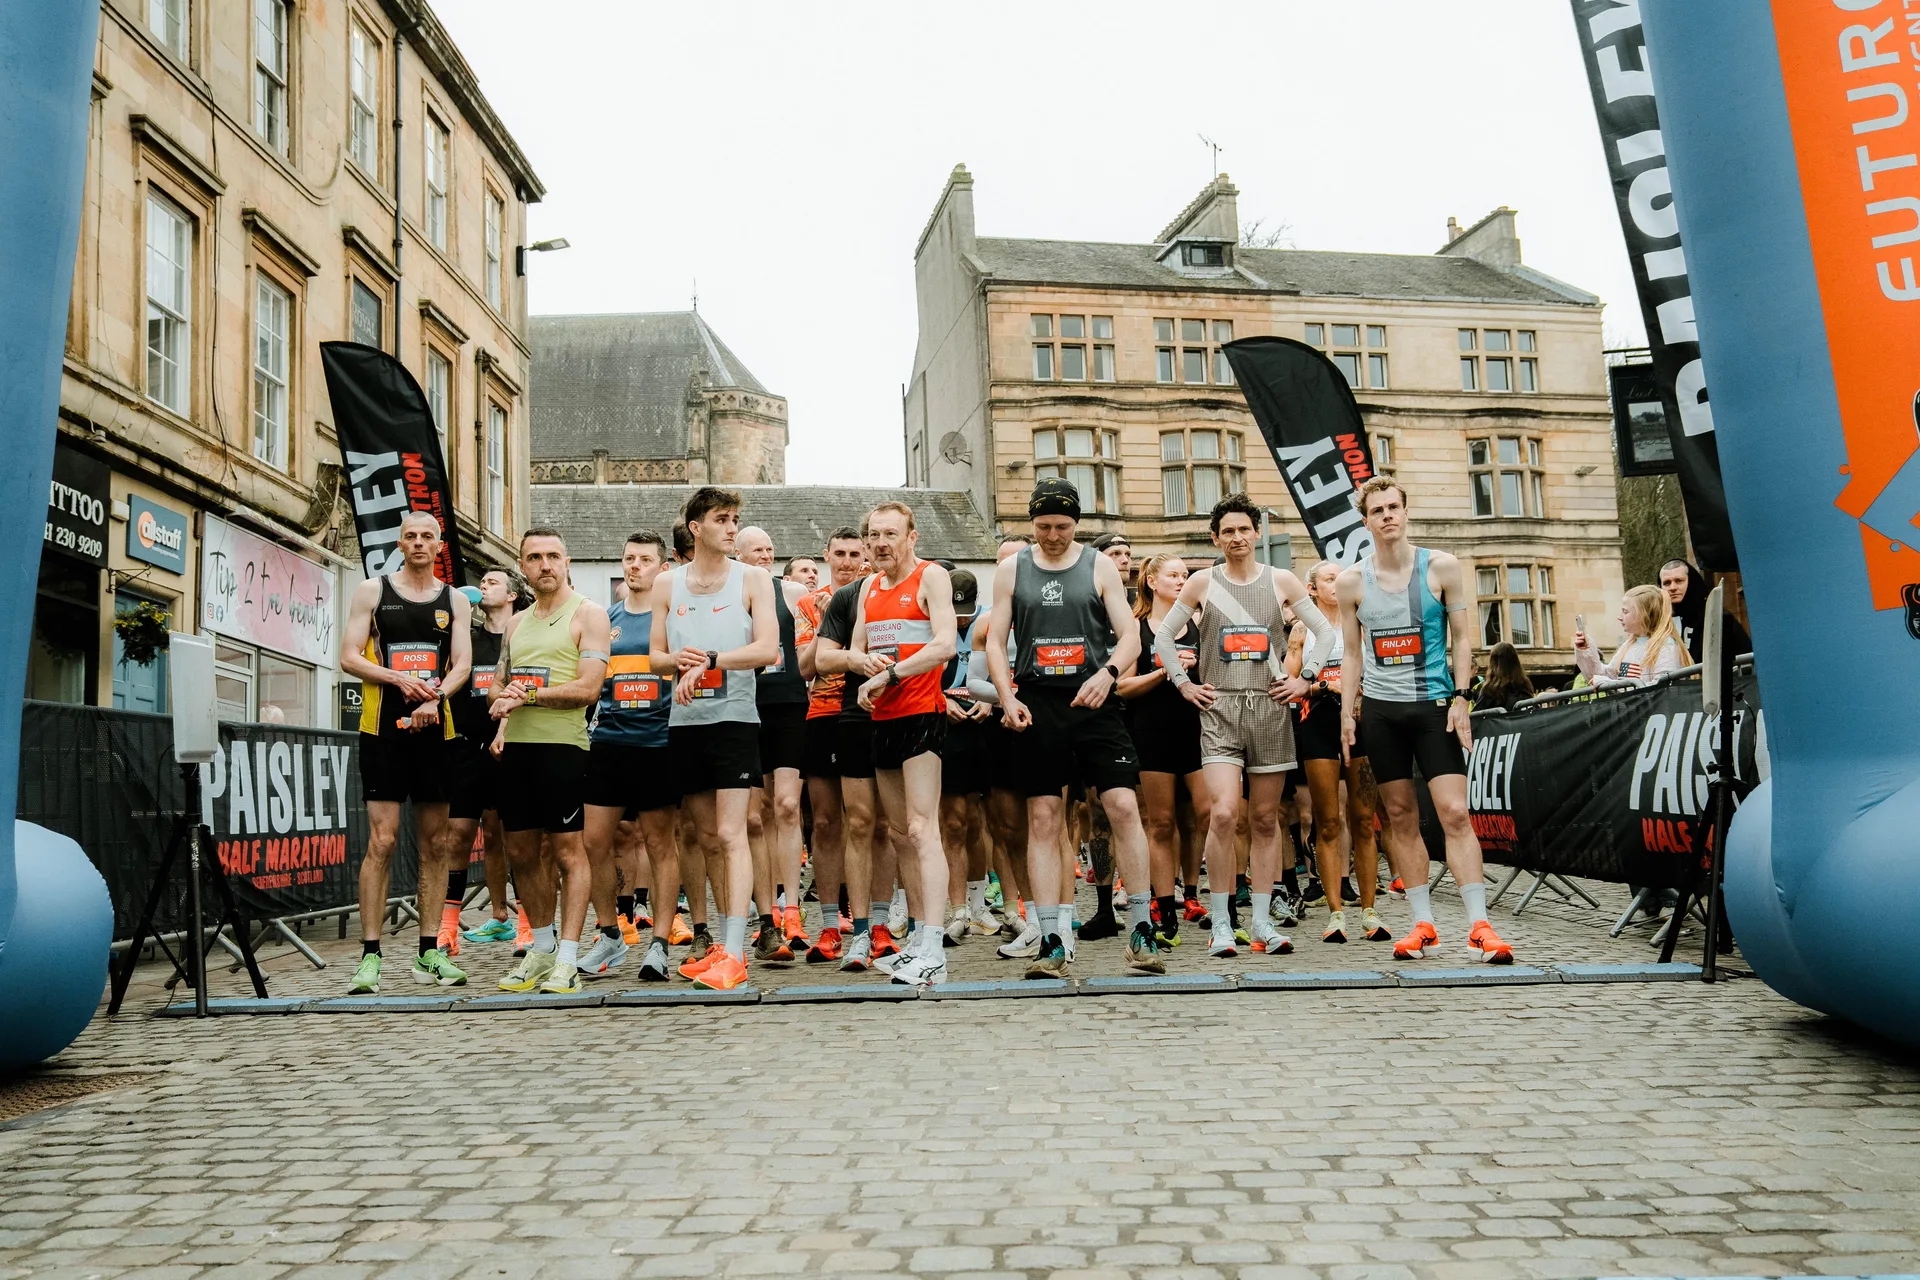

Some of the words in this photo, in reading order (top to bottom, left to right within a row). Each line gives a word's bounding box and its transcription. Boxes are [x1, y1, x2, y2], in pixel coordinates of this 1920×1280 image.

[1831, 0, 1920, 301] FUTUR
[1336, 433, 1372, 488] HON
[56, 526, 76, 549] 230
[77, 534, 103, 559] 9209
[142, 519, 182, 551] allstaff
[210, 550, 237, 613] Tip
[244, 561, 255, 604] 2
[289, 573, 333, 655] beauty
[403, 654, 428, 662] ROSS
[1048, 648, 1073, 657] JACK
[1382, 638, 1413, 648] FINLAY
[623, 684, 649, 692] DAVID
[952, 688, 970, 696] DON
[1462, 733, 1521, 811] ISLEY
[1630, 709, 1766, 815] PAIS
[200, 741, 350, 835] PAISLEY
[1642, 817, 1693, 853] HALF
[218, 840, 261, 876] HALF
[266, 834, 346, 872] MARATHON
[297, 869, 324, 885] SCOTLAND
